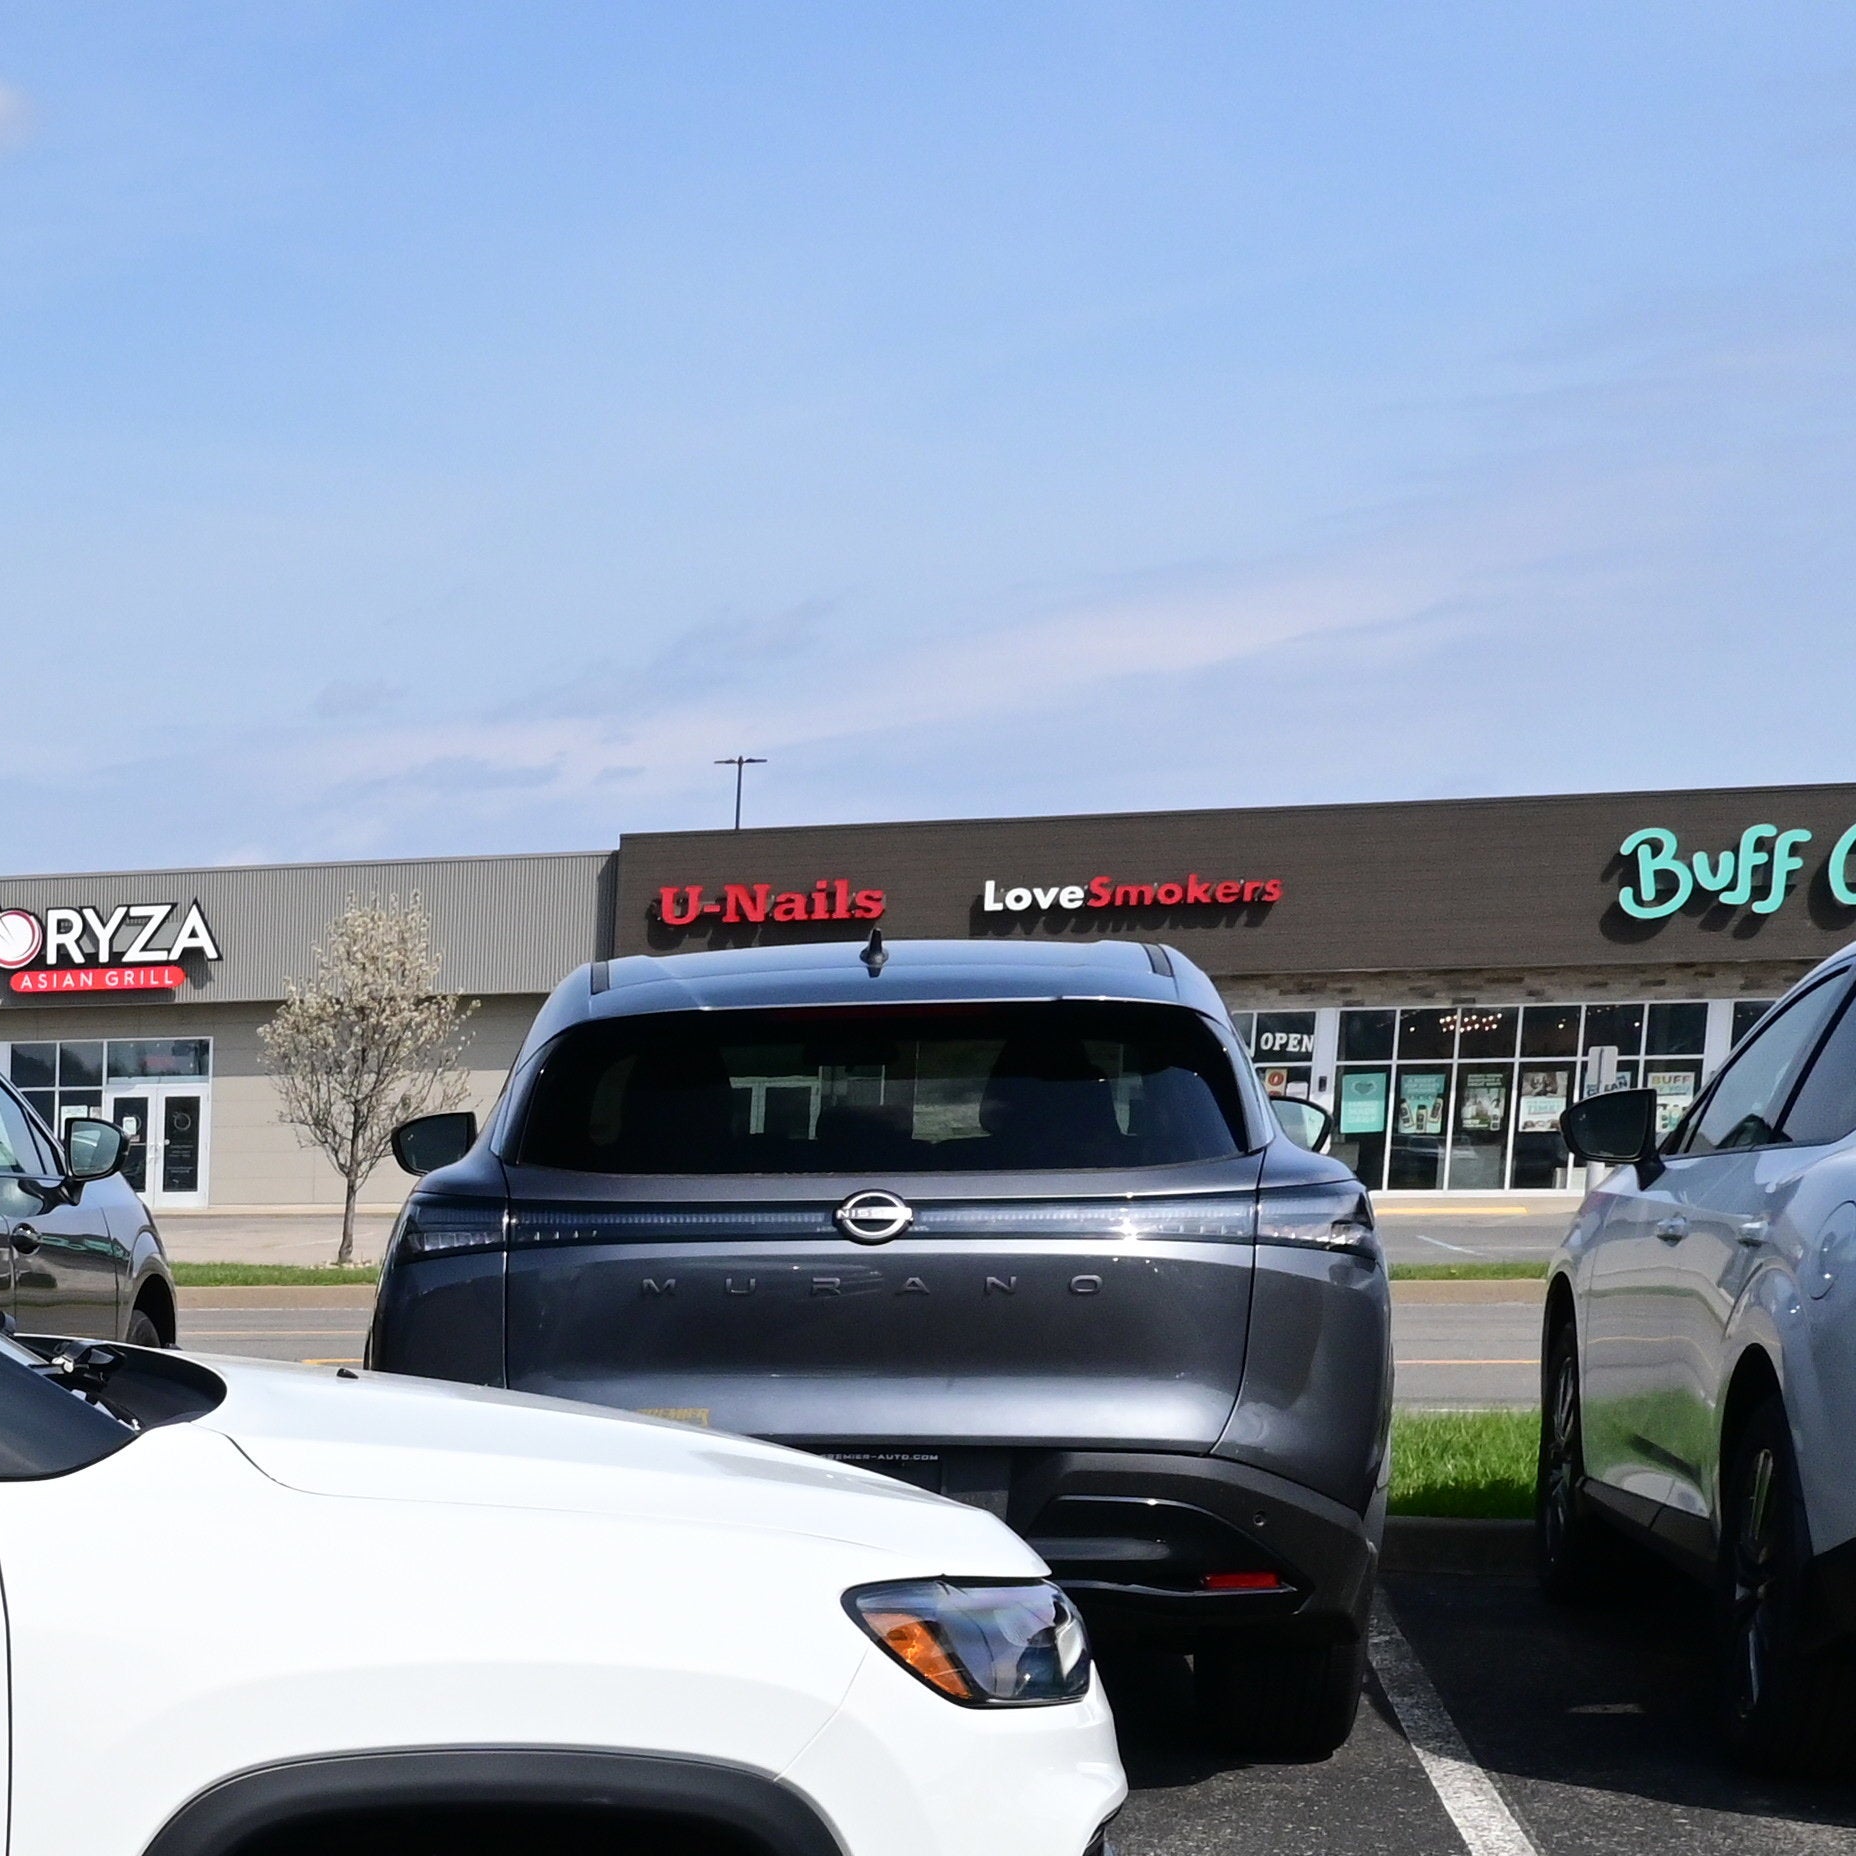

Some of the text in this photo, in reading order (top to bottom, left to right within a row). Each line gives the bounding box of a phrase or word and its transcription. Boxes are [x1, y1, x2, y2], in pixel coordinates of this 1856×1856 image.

[1619, 823, 1812, 919] Buff
[660, 878, 885, 925] U-Nails
[983, 874, 1283, 912] LoveSmokers
[20, 969, 174, 989] ASIAN GRILL
[1260, 1032, 1315, 1053] OPEN
[642, 1274, 1104, 1297] MURANO
